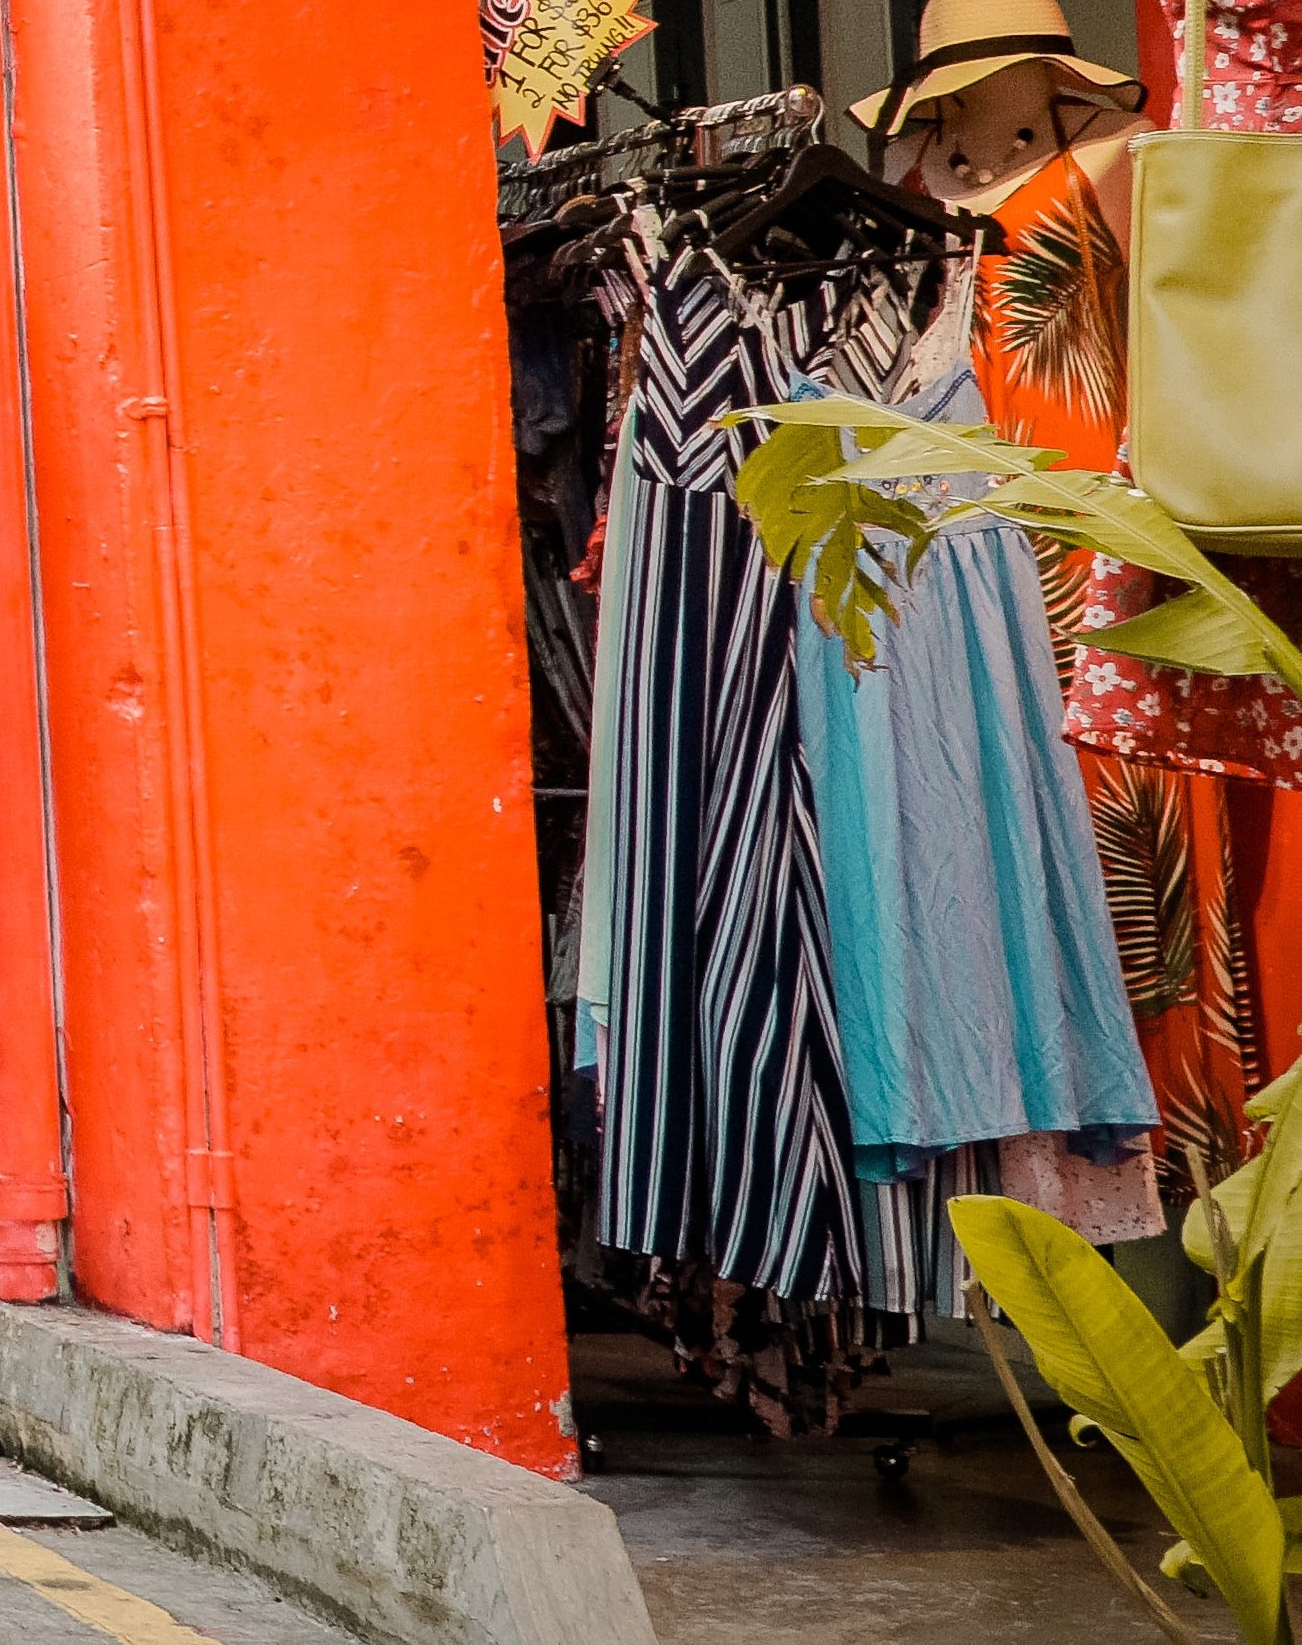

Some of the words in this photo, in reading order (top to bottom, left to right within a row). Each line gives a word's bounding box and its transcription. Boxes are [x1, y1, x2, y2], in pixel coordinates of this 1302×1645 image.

[509, 16, 556, 68] FOR
[499, 68, 527, 94] 1
[523, 87, 546, 109] 2
[538, 39, 586, 81] FOR
[551, 82, 580, 111] NO
